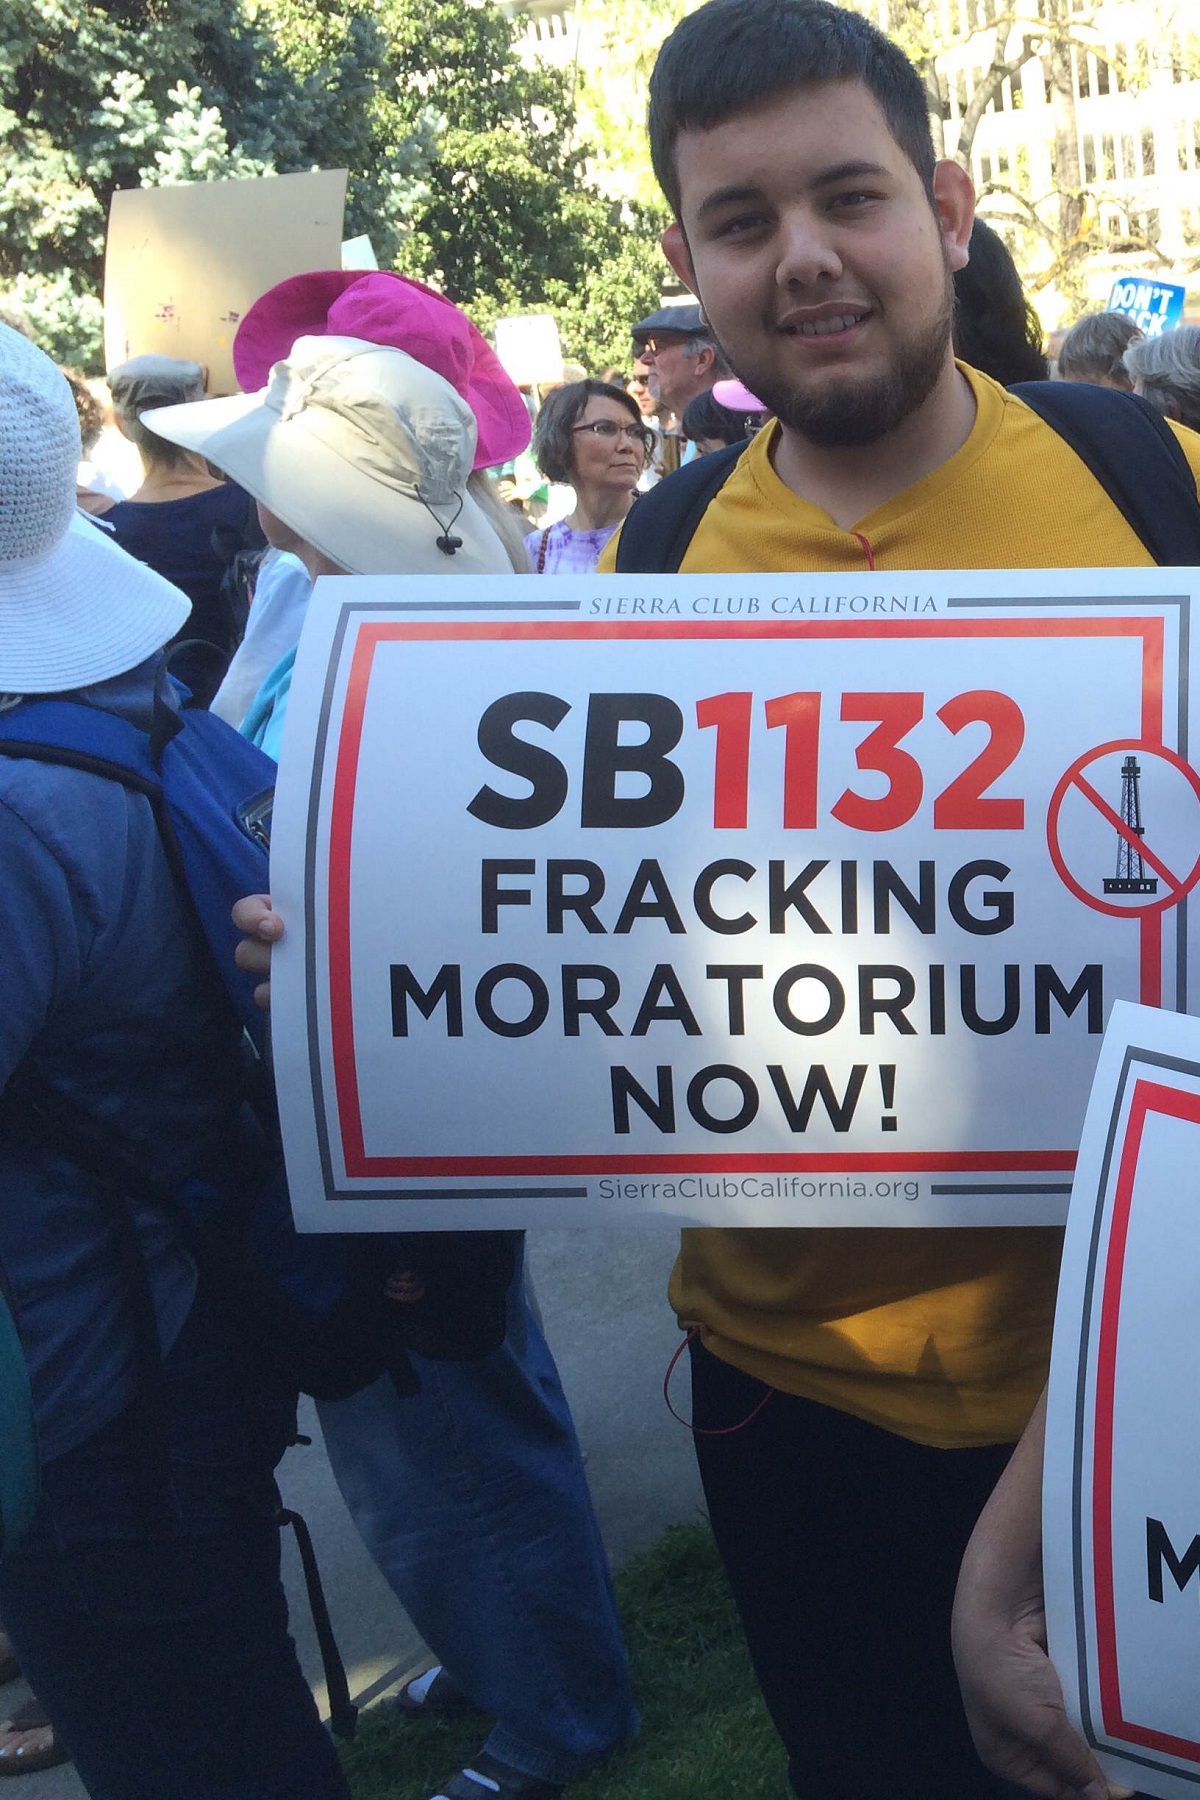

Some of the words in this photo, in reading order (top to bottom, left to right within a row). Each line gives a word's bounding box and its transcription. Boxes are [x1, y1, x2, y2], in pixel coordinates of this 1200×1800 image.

[1110, 283, 1174, 315] DON'T
[589, 597, 681, 615] SIERRA
[692, 596, 760, 614] CLUB
[771, 595, 939, 613] CALIFORNIA
[466, 691, 1025, 832] SB1132
[482, 858, 1015, 936] FRACKING
[390, 963, 1104, 1038] MORATORIUM
[610, 1063, 898, 1134] NOW!
[599, 1177, 919, 1201] SierraClubCalifornia.org
